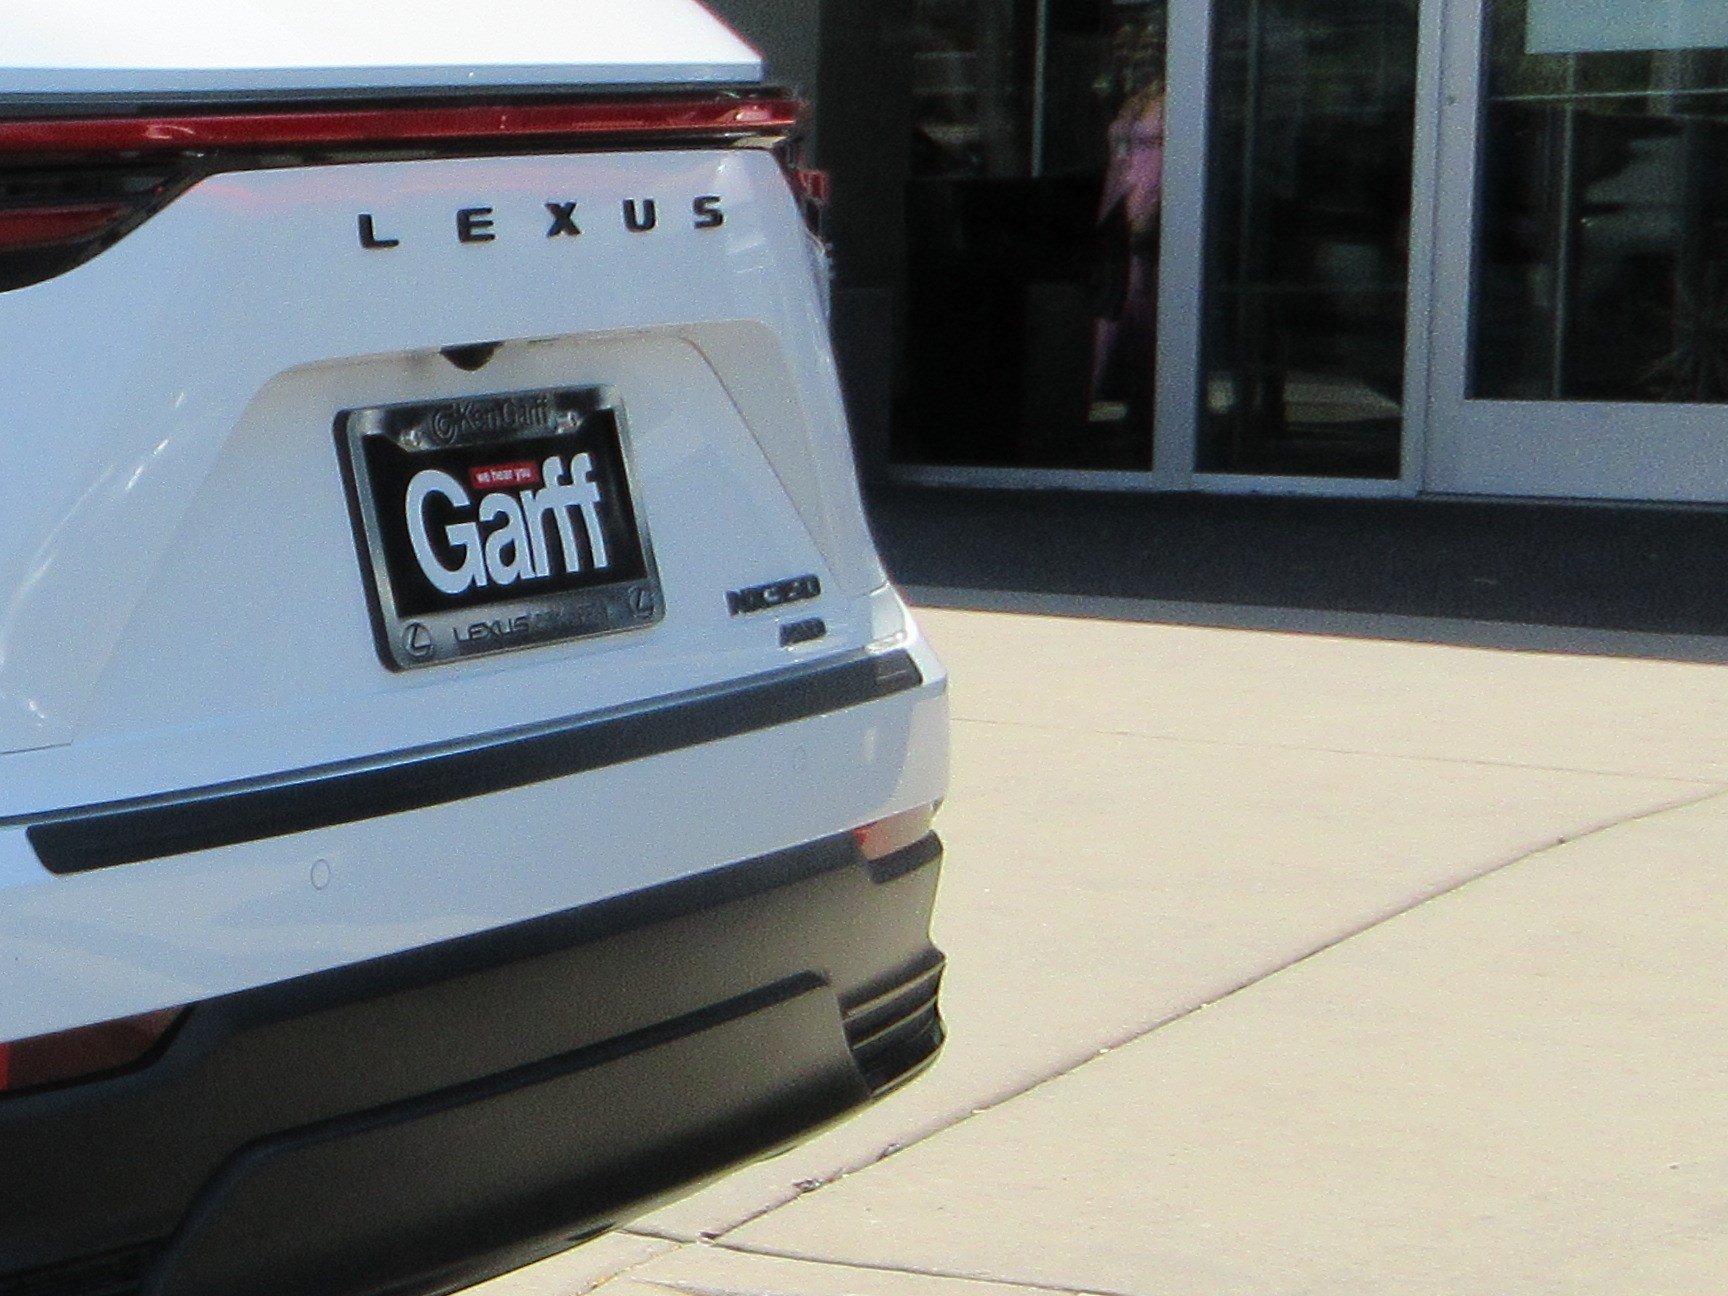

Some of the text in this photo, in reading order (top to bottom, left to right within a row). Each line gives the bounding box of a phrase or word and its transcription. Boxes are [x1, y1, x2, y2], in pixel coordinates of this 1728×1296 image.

[357, 195, 724, 248] LEXUS
[405, 452, 610, 594] Garff
[452, 615, 529, 643] LEXUS
